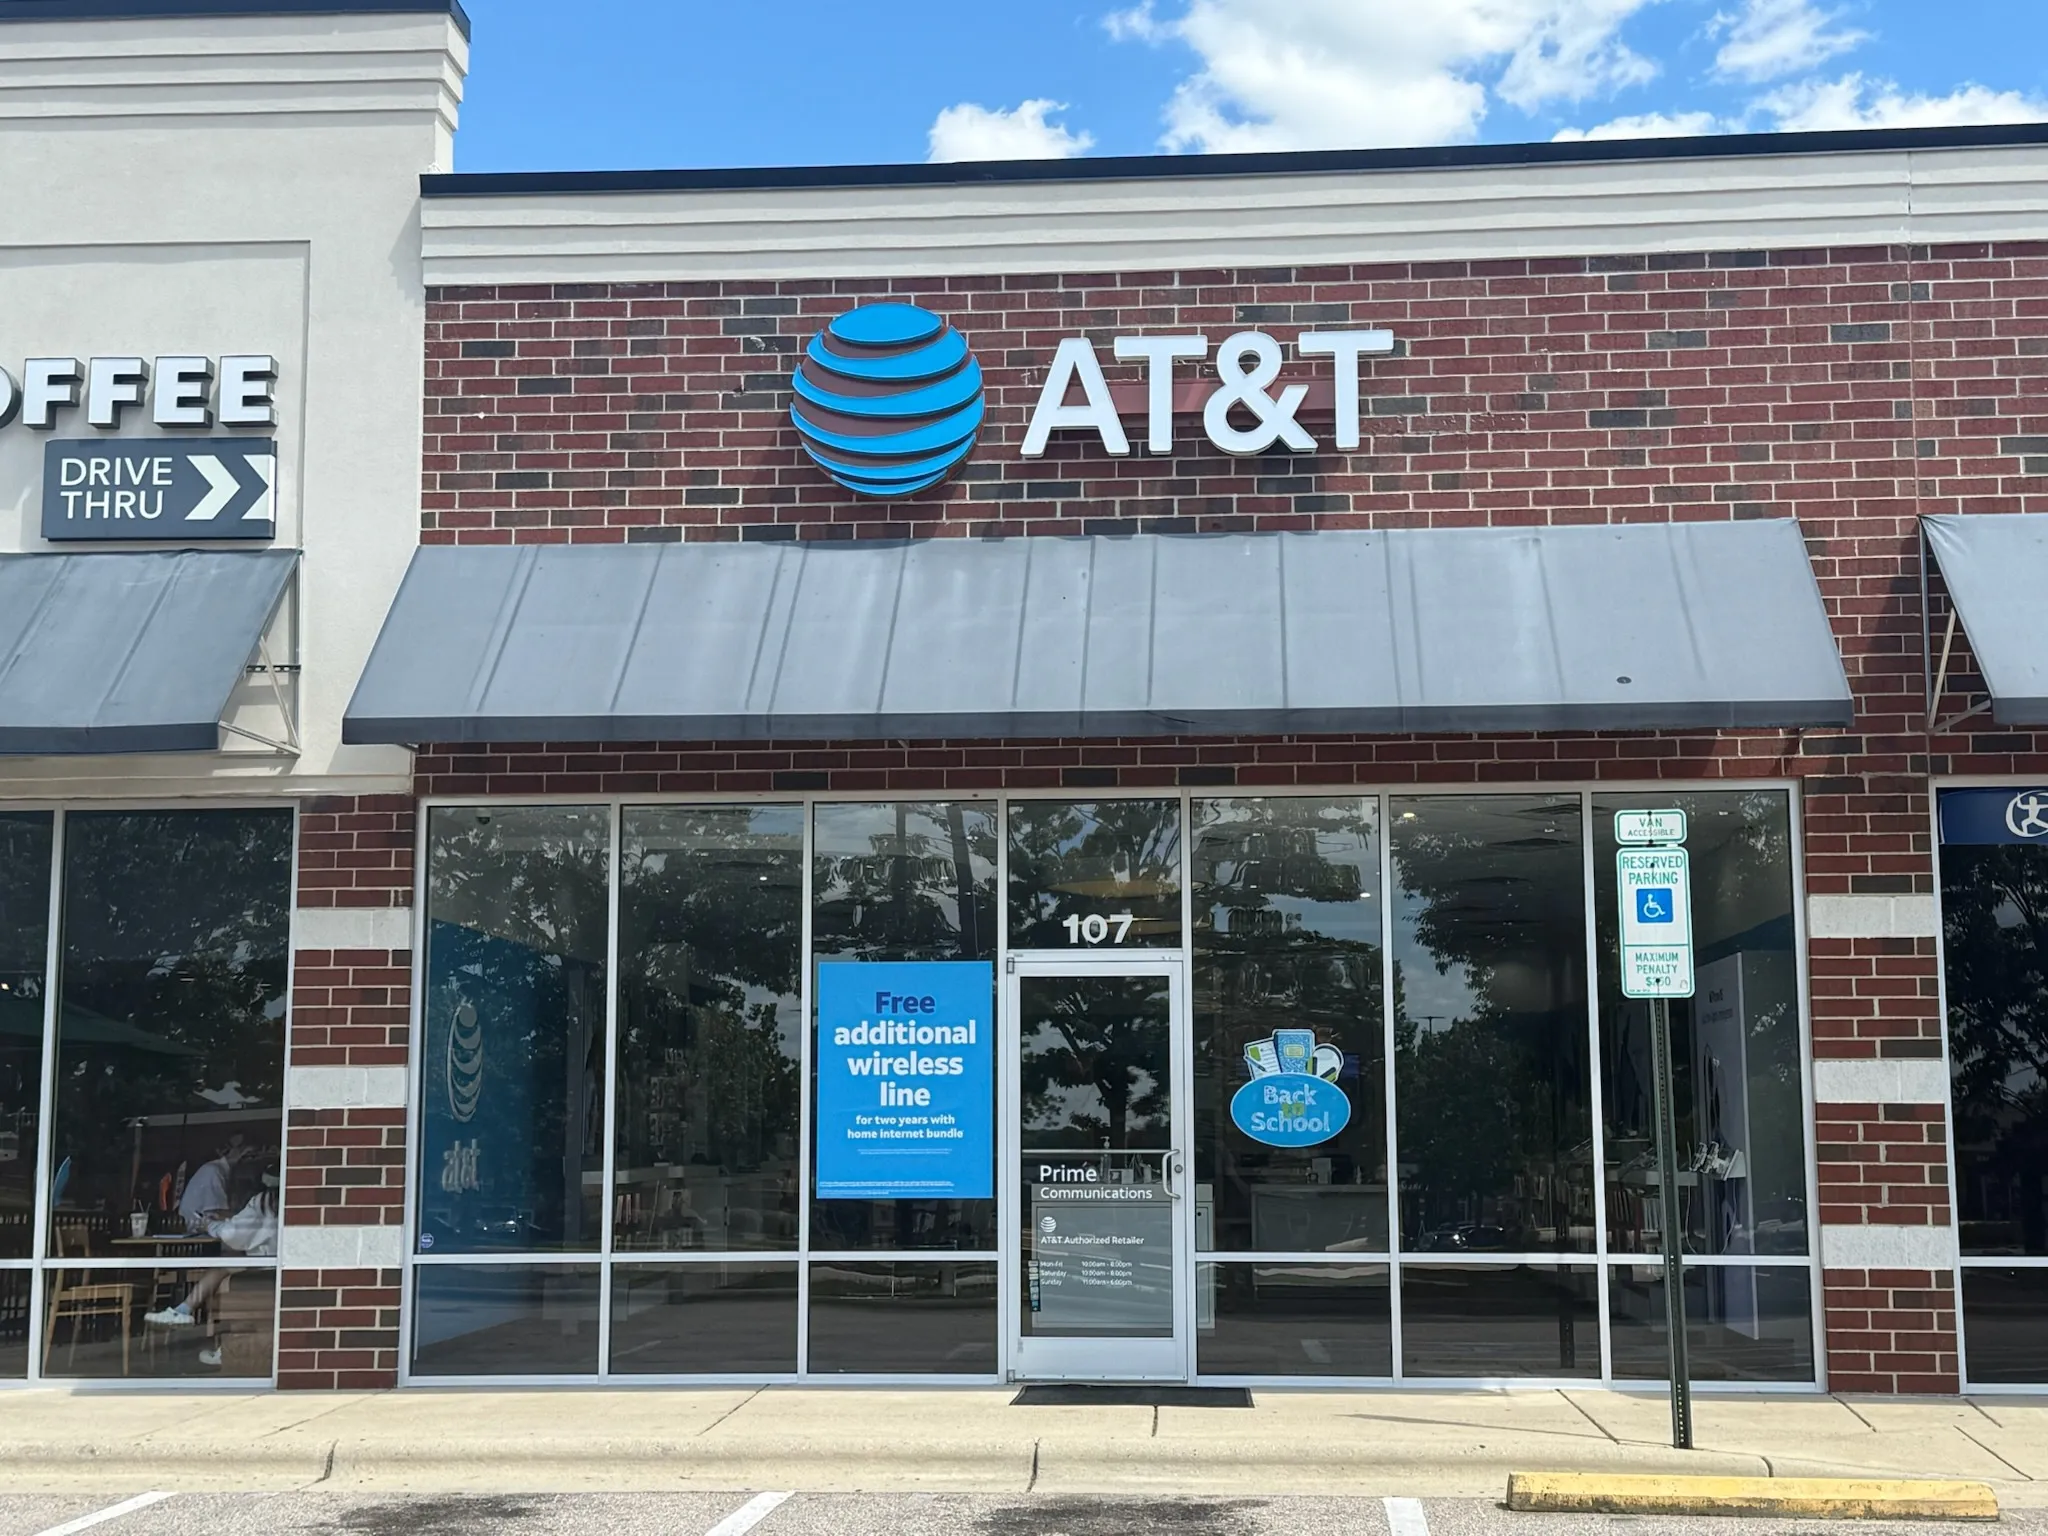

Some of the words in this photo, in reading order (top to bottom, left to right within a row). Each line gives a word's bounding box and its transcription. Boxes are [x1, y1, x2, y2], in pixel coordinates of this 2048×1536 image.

[1020, 329, 1394, 459] AT&T
[60, 457, 173, 486] DRIVE
[60, 490, 163, 520] THRU
[1638, 817, 1663, 828] VAN
[1627, 828, 1675, 837] ACCESSIBLE
[1622, 855, 1684, 869] RESERVED
[1628, 871, 1679, 885] PARKING
[1062, 913, 1133, 944] 107
[1635, 952, 1679, 962] MAXIMUM
[1636, 964, 1677, 974] PENALTY
[876, 991, 936, 1014] Free
[834, 1019, 977, 1045] additional
[847, 1050, 964, 1076] wireless
[880, 1081, 931, 1107] line
[1263, 1083, 1317, 1105] Back
[856, 1115, 872, 1125] for
[875, 1115, 897, 1125] two
[898, 1116, 928, 1127] years
[930, 1114, 955, 1125] with
[1251, 1110, 1331, 1132] School
[847, 1129, 878, 1139] home
[880, 1129, 924, 1139] internet
[926, 1128, 964, 1139] bundle
[1039, 1164, 1097, 1182] Prime
[1040, 1187, 1153, 1199] Communications
[1040, 1236, 1063, 1244] AT&T
[1064, 1236, 1110, 1245] Authorized
[1112, 1236, 1144, 1244] Retailer
